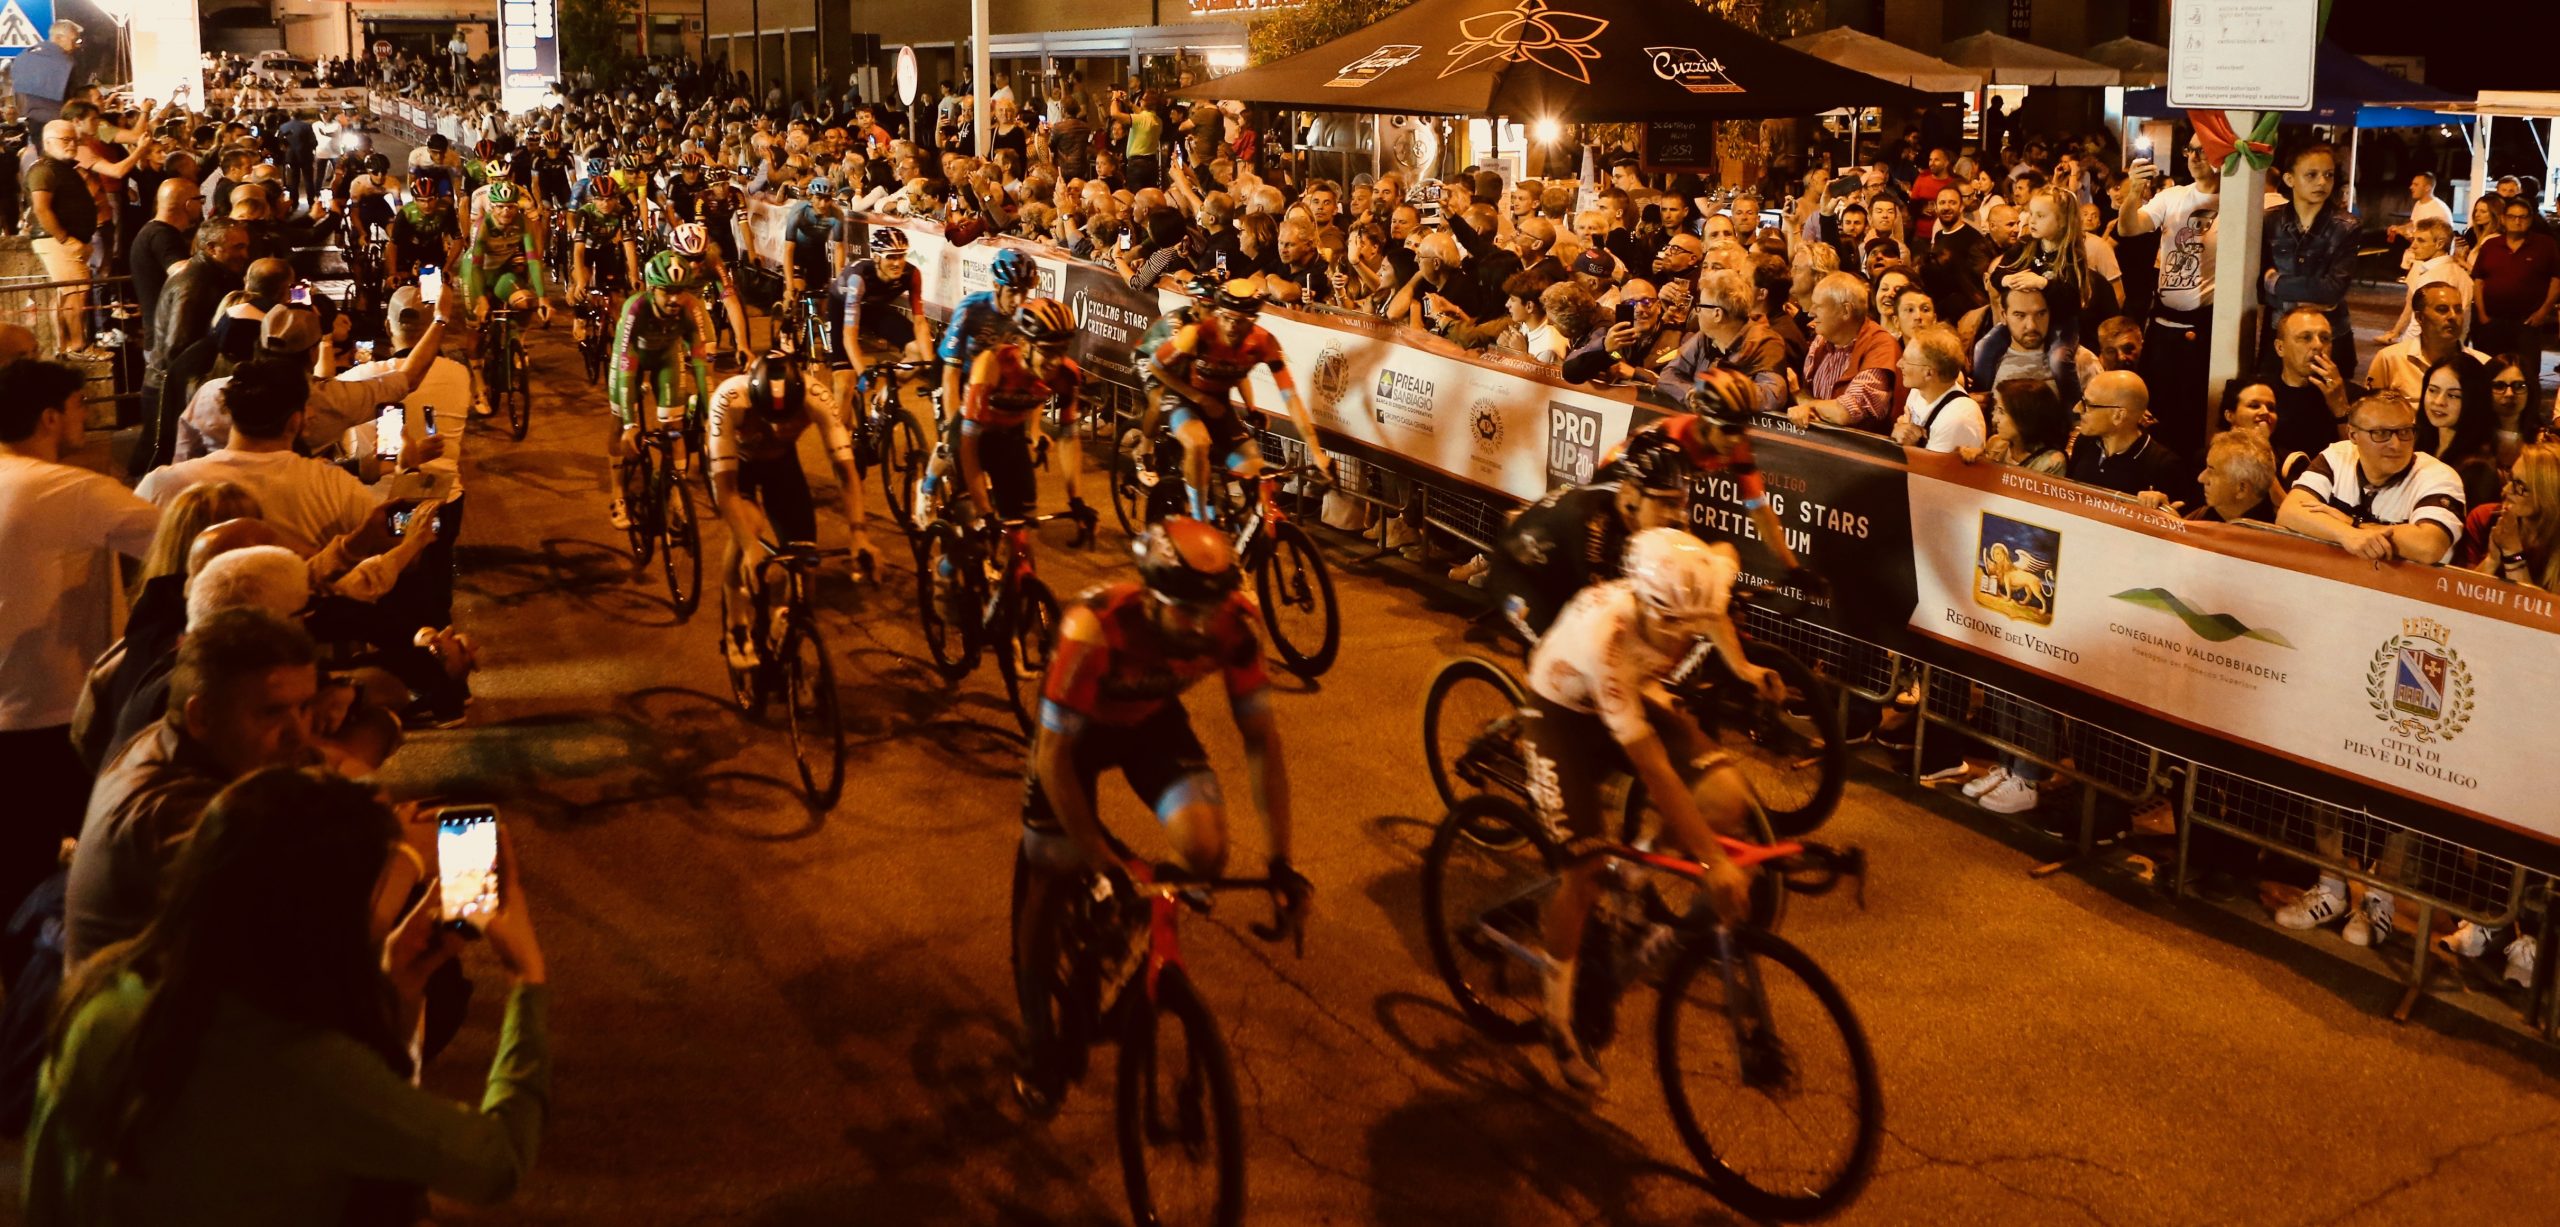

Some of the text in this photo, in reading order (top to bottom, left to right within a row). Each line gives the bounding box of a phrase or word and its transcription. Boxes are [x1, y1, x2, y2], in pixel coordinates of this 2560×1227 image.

[1653, 52, 1724, 80] Cuzziol
[1088, 300, 1148, 330] CYCLING STARS
[1087, 319, 1127, 343] CRITERIUM
[1392, 389, 1433, 411] SANBIAGIO
[1396, 373, 1434, 397] PREALPI
[1552, 409, 1596, 447] PRO
[1762, 417, 1773, 429] OF
[1551, 438, 1577, 471] UP
[1694, 476, 1869, 539] CYCLNG STARS
[1693, 503, 1811, 555] CRITEUM
[2437, 577, 2552, 617] A NIGHT FULL
[1946, 608, 2079, 665] REGIONE DEL VENETO
[2109, 623, 2287, 683] CONEGLIANO VALDOBBIADENE
[2219, 674, 2257, 690] Superiore
[2344, 739, 2477, 789] PIEVE DI SOLIGO
[2381, 738, 2440, 763] CITTÀ DI
